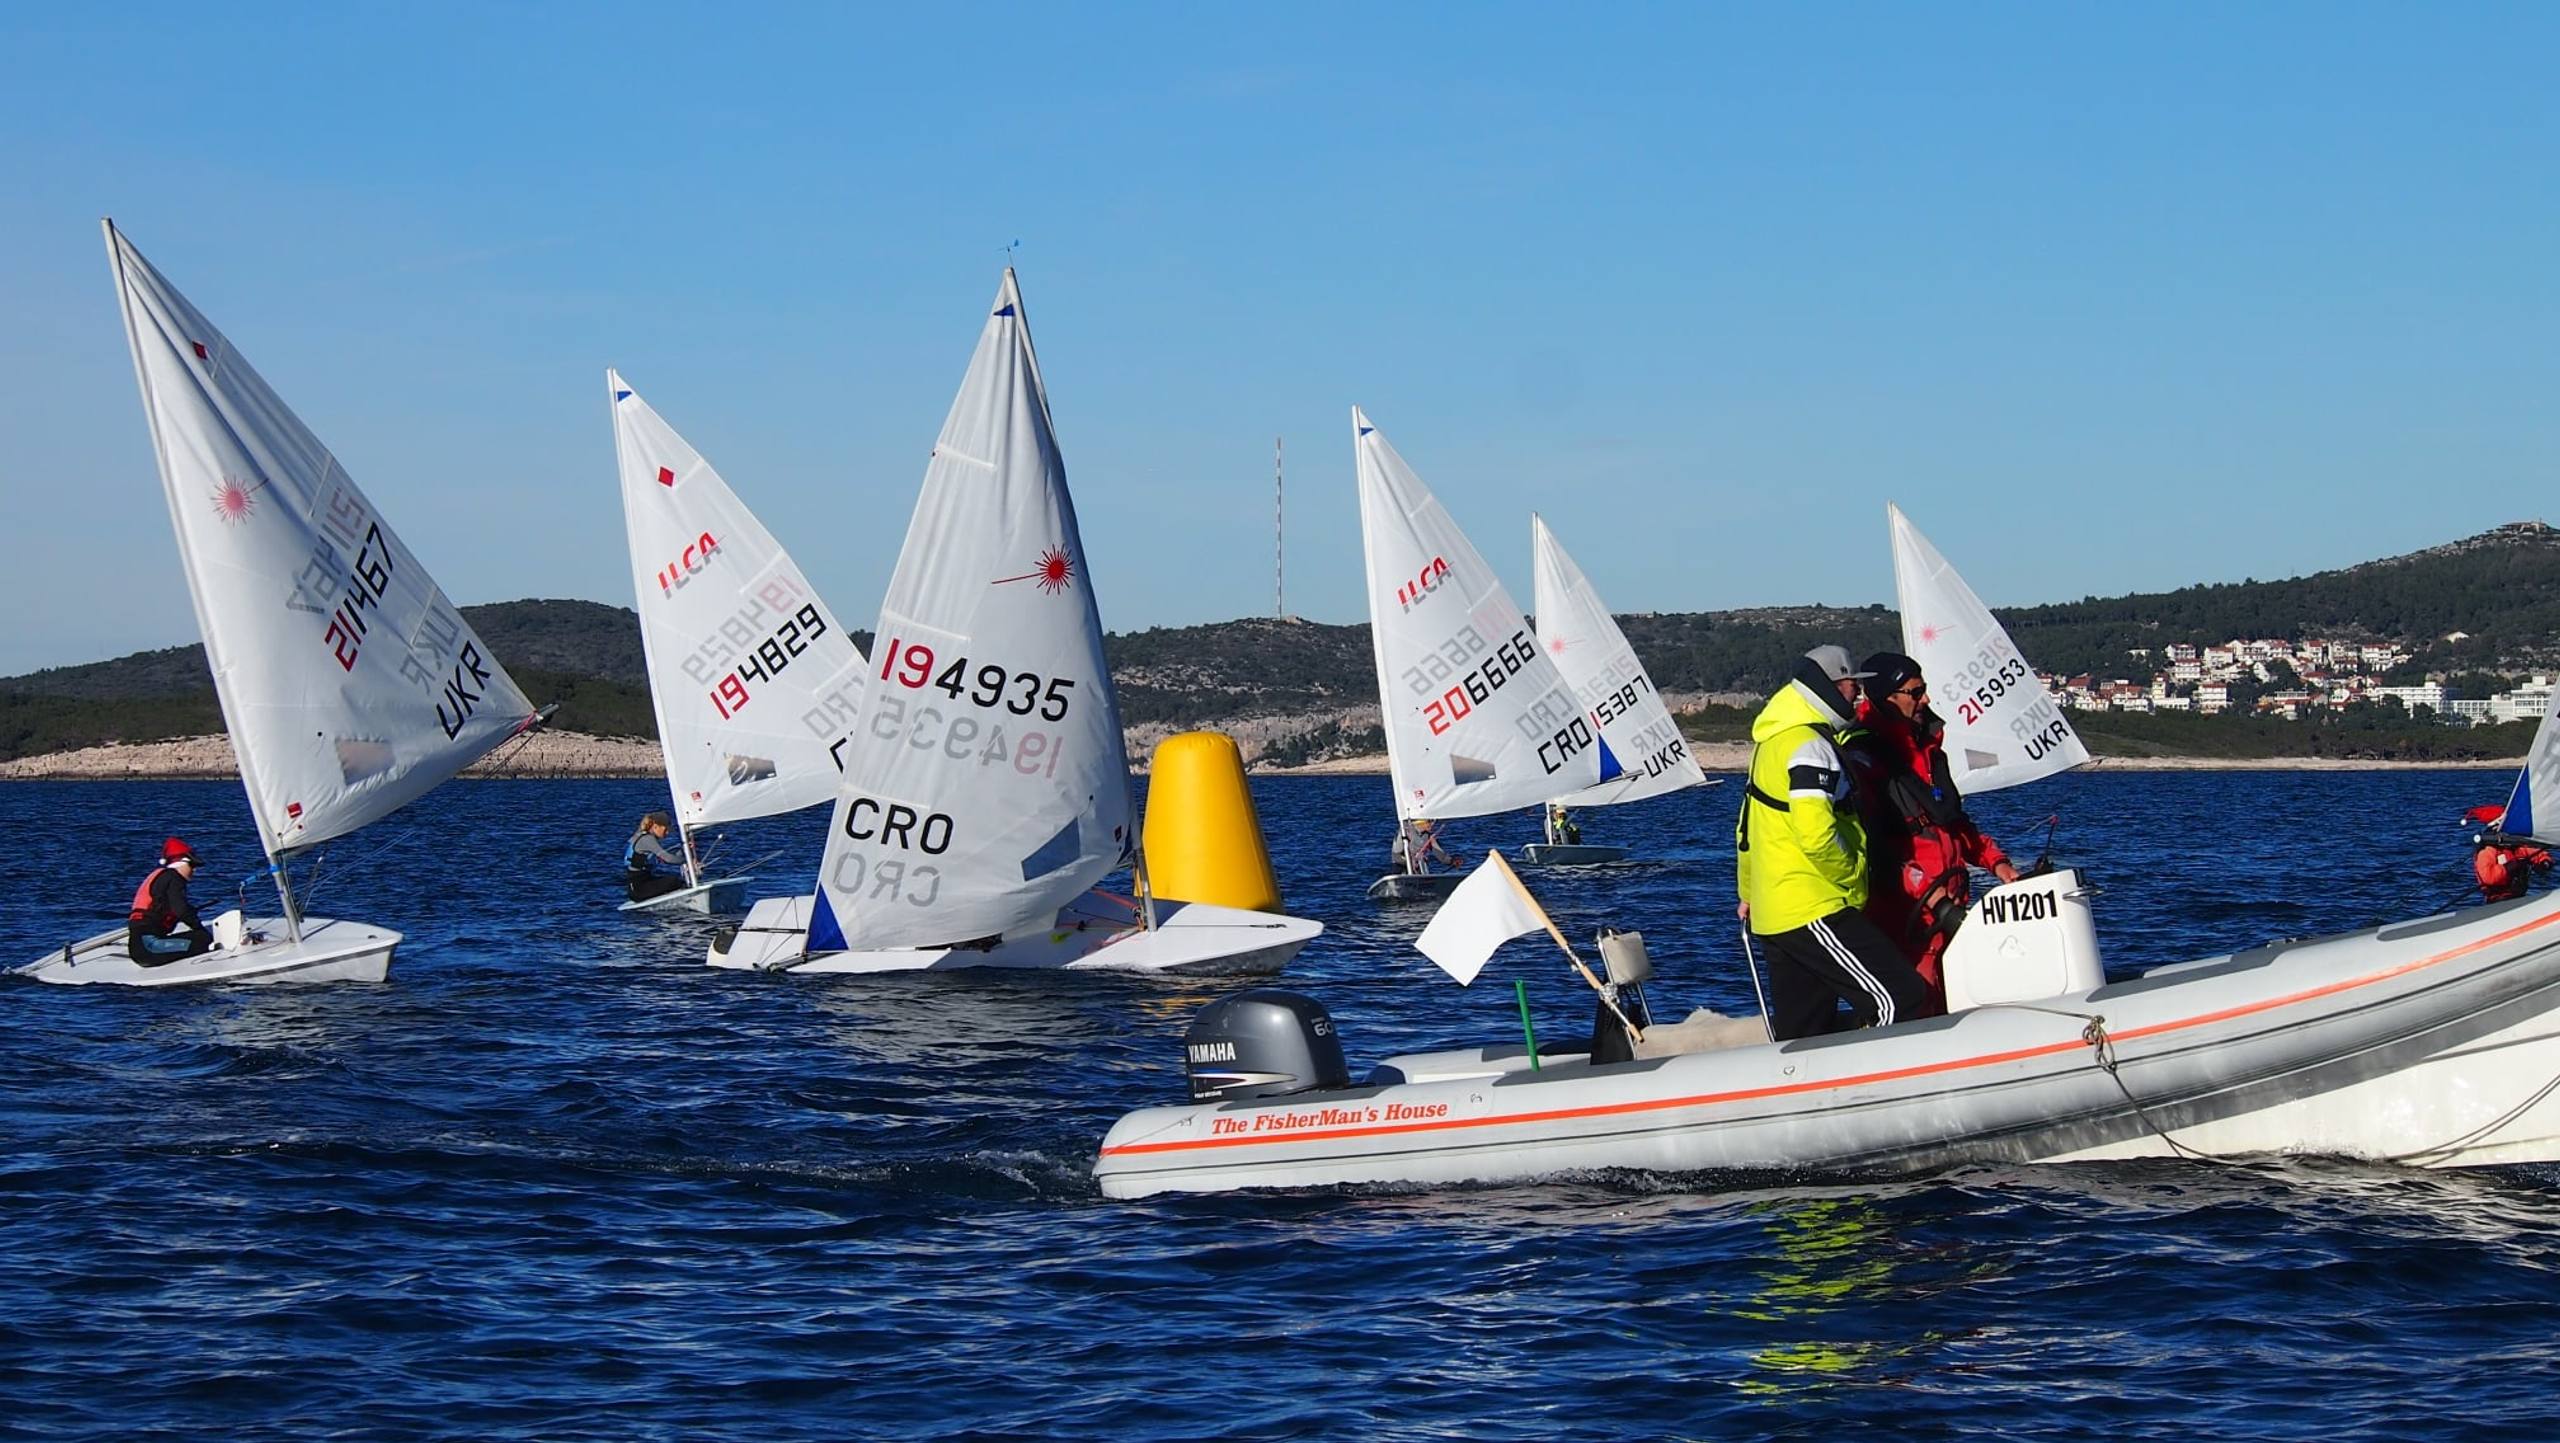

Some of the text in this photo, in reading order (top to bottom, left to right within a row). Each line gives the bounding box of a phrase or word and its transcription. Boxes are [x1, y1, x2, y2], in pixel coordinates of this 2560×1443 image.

[657, 532, 726, 600] ILCA
[1397, 557, 1454, 614] ILCA
[324, 521, 393, 672] 211467
[435, 640, 491, 741] UKR
[709, 603, 827, 720] 194829
[880, 638, 1075, 722] 194935
[1423, 630, 1536, 736] 206666
[1589, 674, 1650, 731] 15387
[1958, 658, 2026, 726] 215953
[1537, 716, 1593, 775] CRO
[1644, 739, 1687, 778] UKR
[2024, 719, 2070, 761] UKR
[844, 797, 954, 855] CRO
[1981, 889, 2058, 925] HV1201
[1187, 1042, 1237, 1064] YAMAHA
[1313, 1021, 1335, 1037] 60
[1212, 1102, 1448, 1135] The FisherMan's House
